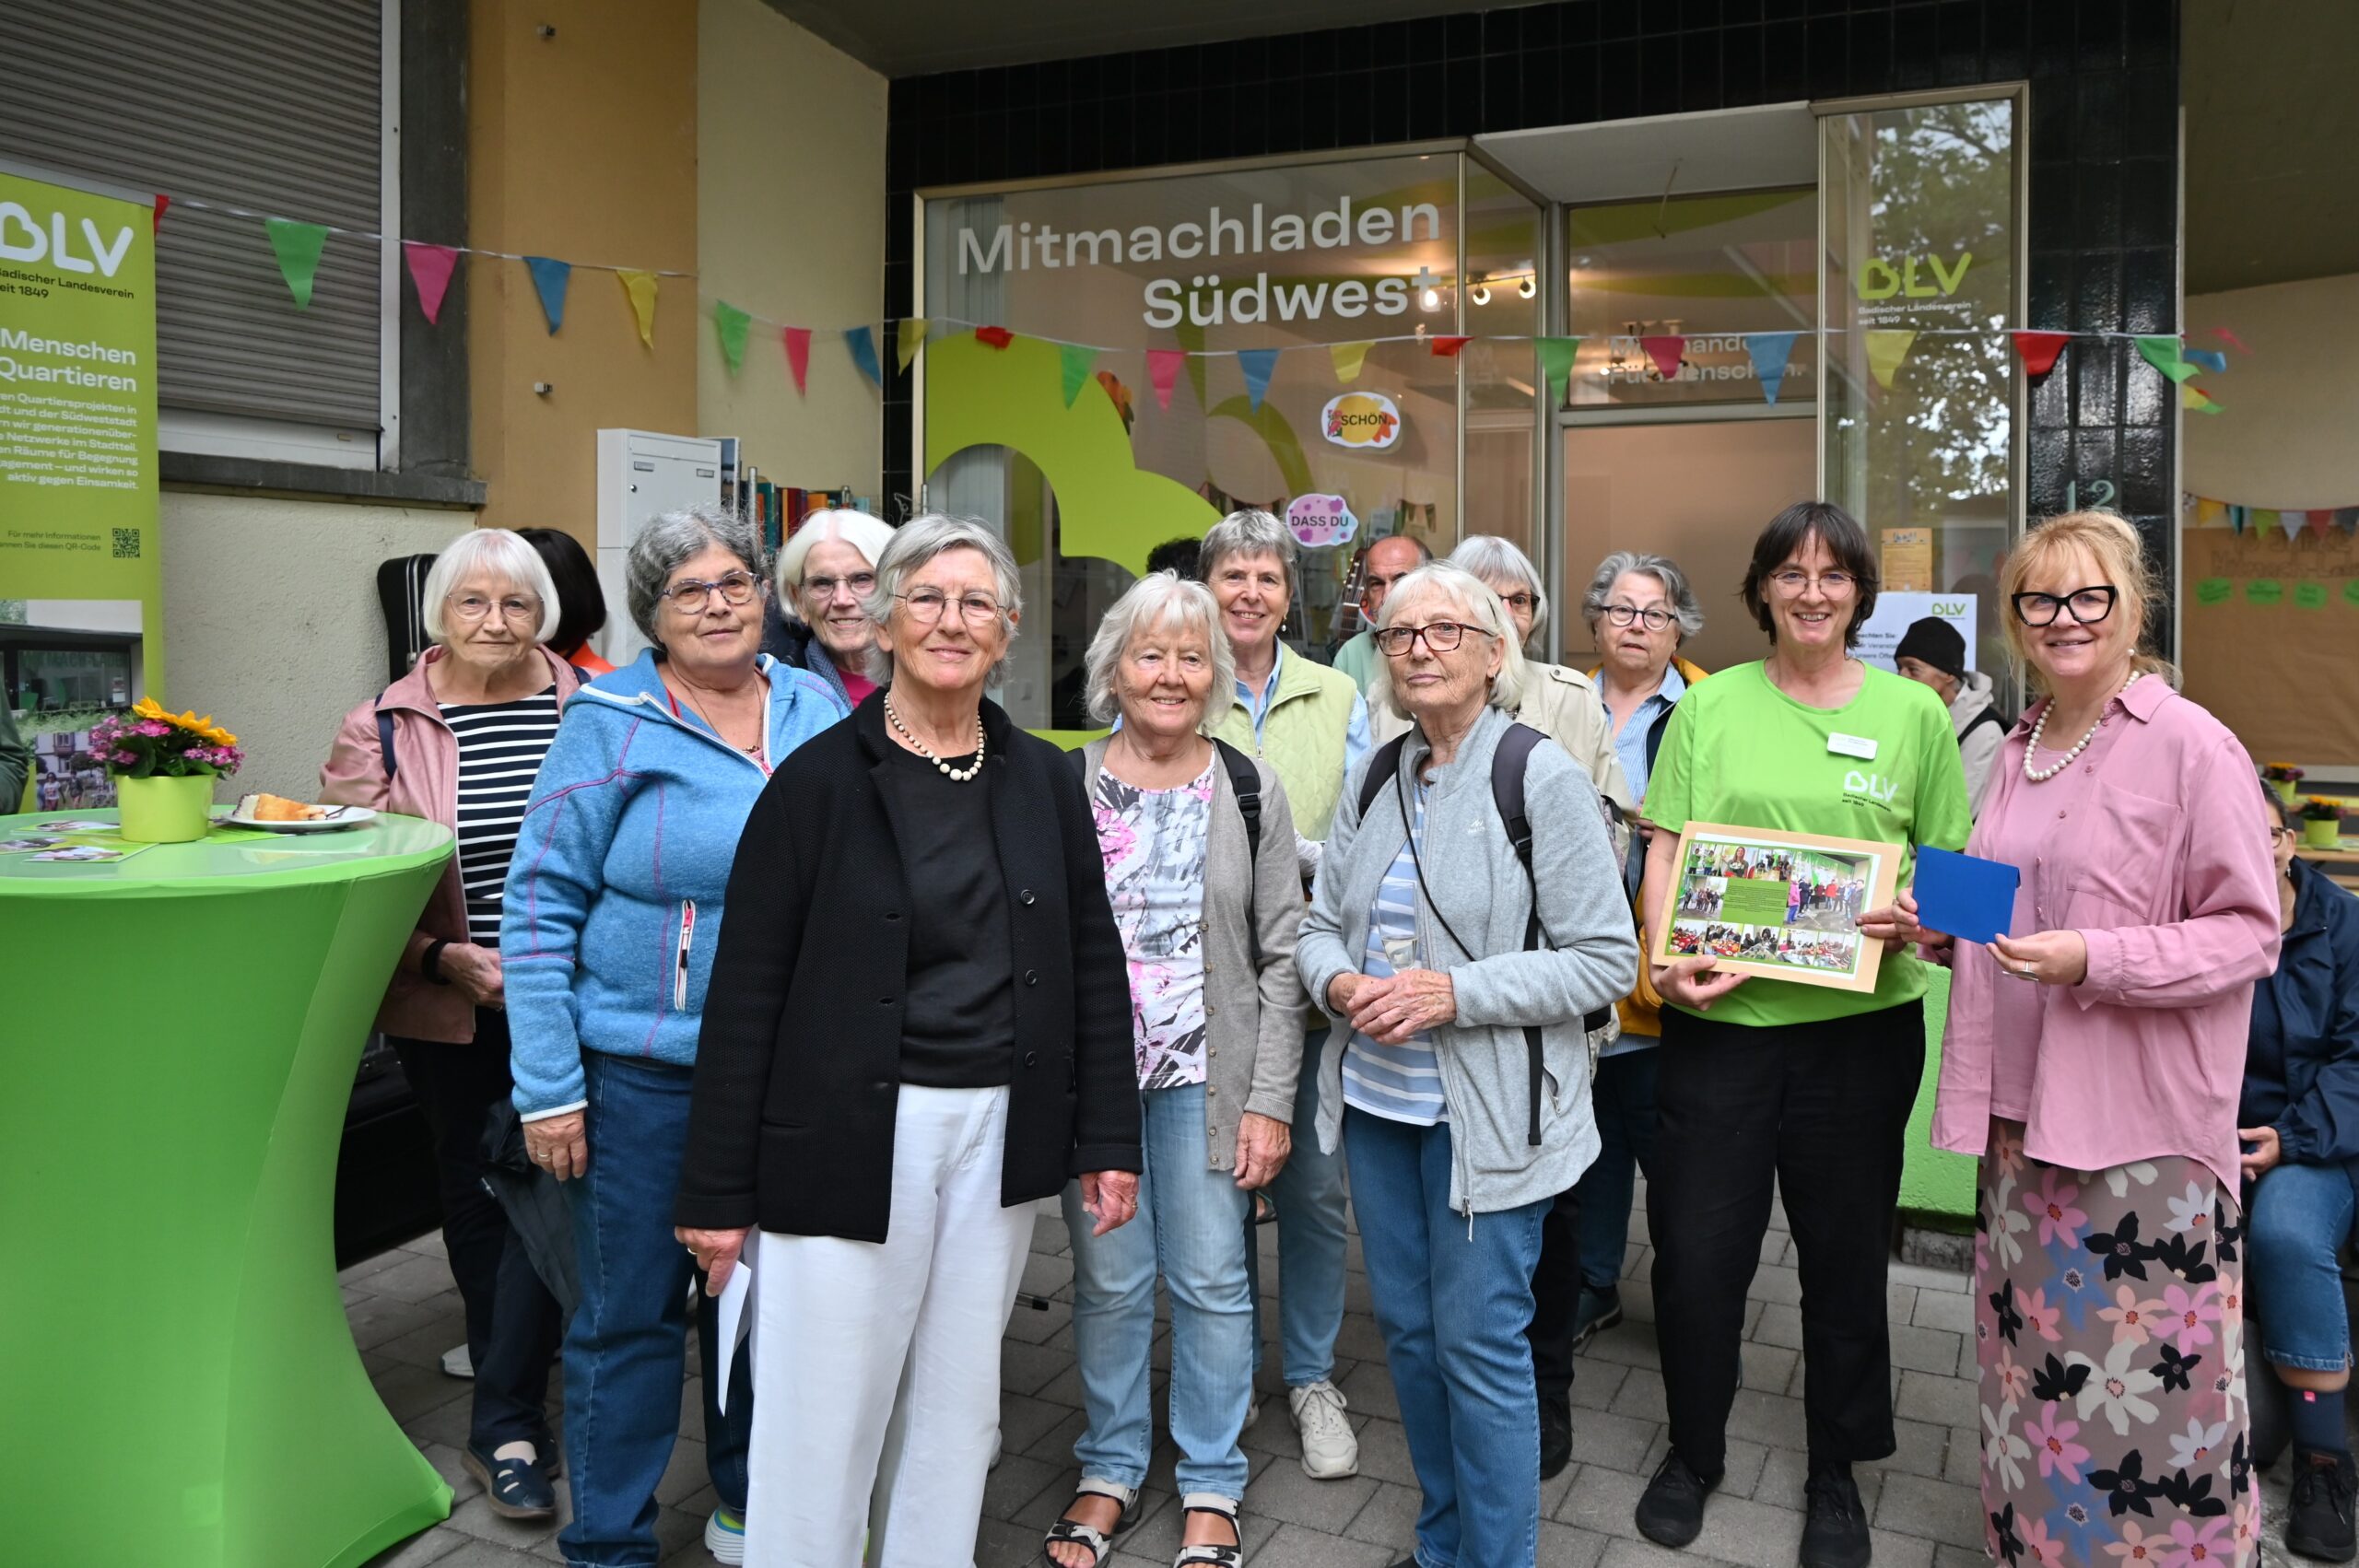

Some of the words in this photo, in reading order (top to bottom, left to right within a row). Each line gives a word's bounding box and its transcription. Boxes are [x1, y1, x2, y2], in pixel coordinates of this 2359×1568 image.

[0, 202, 134, 277] BLV
[958, 196, 1439, 275] Mitmachladen
[0, 268, 55, 285] adischer
[58, 277, 135, 299] Landesverein
[1858, 252, 1972, 300] BLV
[0, 283, 16, 294] eit
[18, 286, 49, 298] 1849
[1143, 266, 1441, 329] Südwest
[1877, 315, 1901, 324] 1849
[0, 327, 136, 366] Menschen
[0, 356, 137, 392] Quartieren
[18, 392, 125, 414] Quartiersprojekten
[127, 404, 137, 415] in
[12, 419, 31, 429] wir
[14, 406, 36, 416] und
[39, 409, 59, 419] der
[61, 410, 137, 427] Südweststadt
[6, 432, 70, 446] Netzwerke
[72, 438, 87, 447] im
[14, 446, 56, 458] Räume
[58, 449, 76, 459] für
[78, 451, 138, 466] Begegnung
[0, 460, 53, 471] agement
[65, 462, 86, 473] und
[88, 465, 124, 476] wirken
[7, 472, 37, 483] aktiv
[39, 475, 74, 486] gegen
[76, 475, 139, 490] Einsamkeit.
[2067, 480, 2115, 510] 12
[1291, 516, 1326, 526] DASS
[1330, 516, 1348, 527] DU
[1844, 770, 1898, 802] BLV
